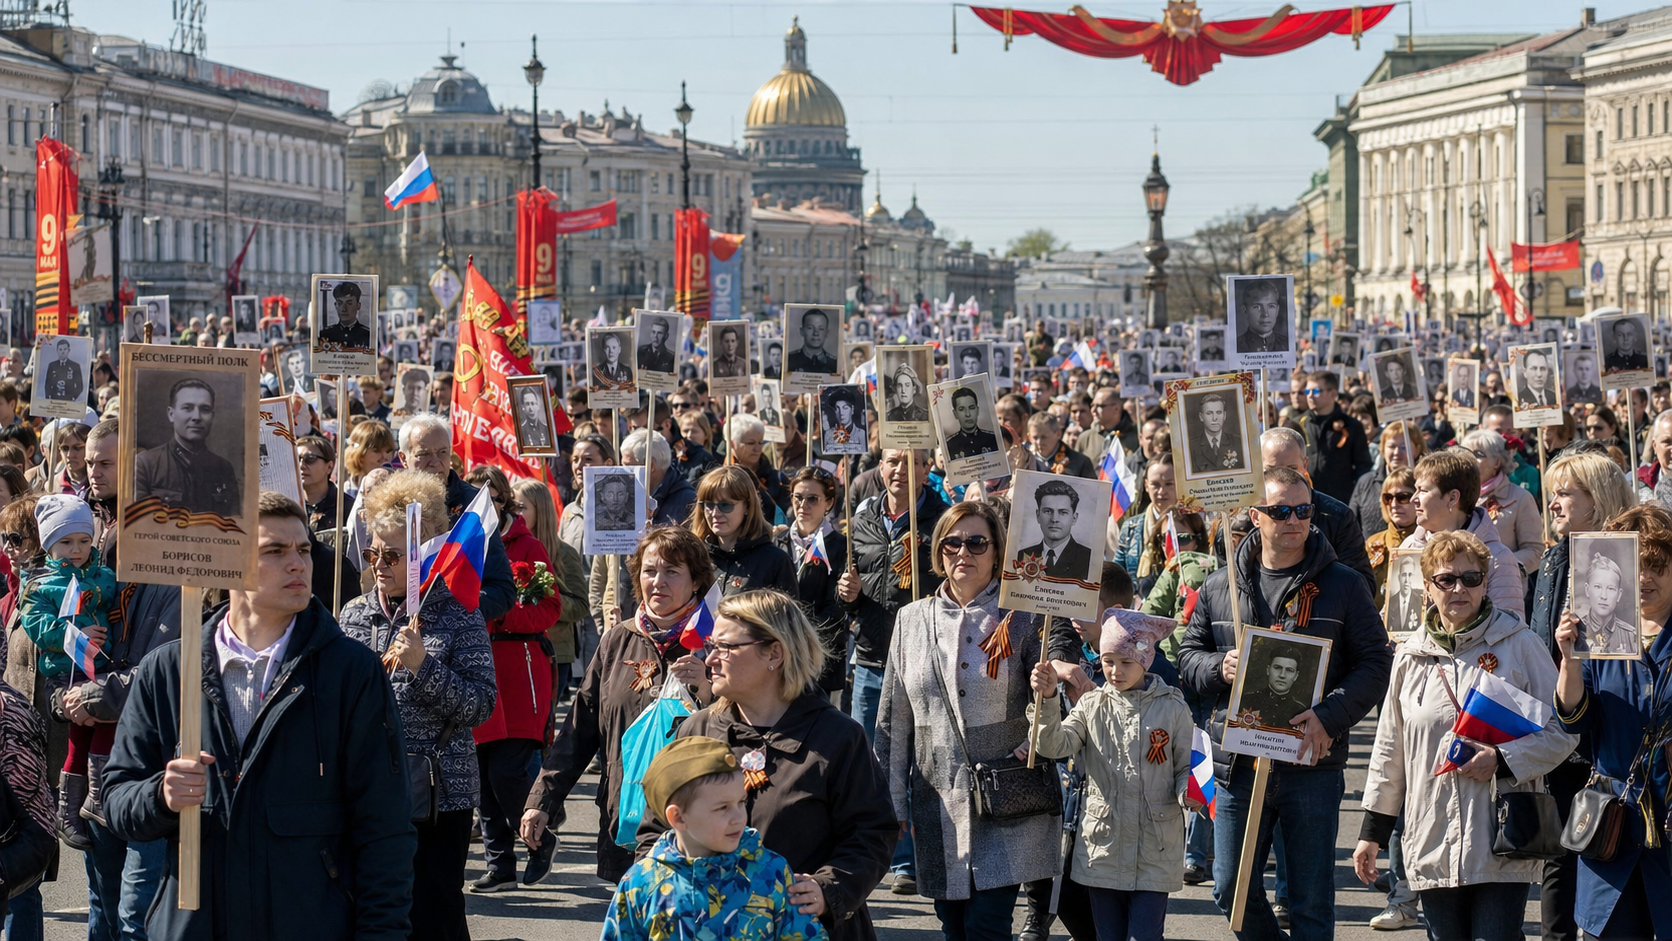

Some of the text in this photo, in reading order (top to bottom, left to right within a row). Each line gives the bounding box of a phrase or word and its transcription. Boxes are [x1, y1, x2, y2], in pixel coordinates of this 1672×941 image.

[41, 213, 57, 255] 9
[536, 243, 552, 273] 9
[692, 253, 706, 279] 9
[131, 352, 249, 367] БЕССМЕРТНЫЙ ПОЛК
[134, 532, 159, 540] ГЕРОЙ
[160, 533, 212, 544] СОВЕТСКОГО
[162, 550, 212, 563] БОРИСОВ
[130, 562, 175, 576] ЛЕОНИД
